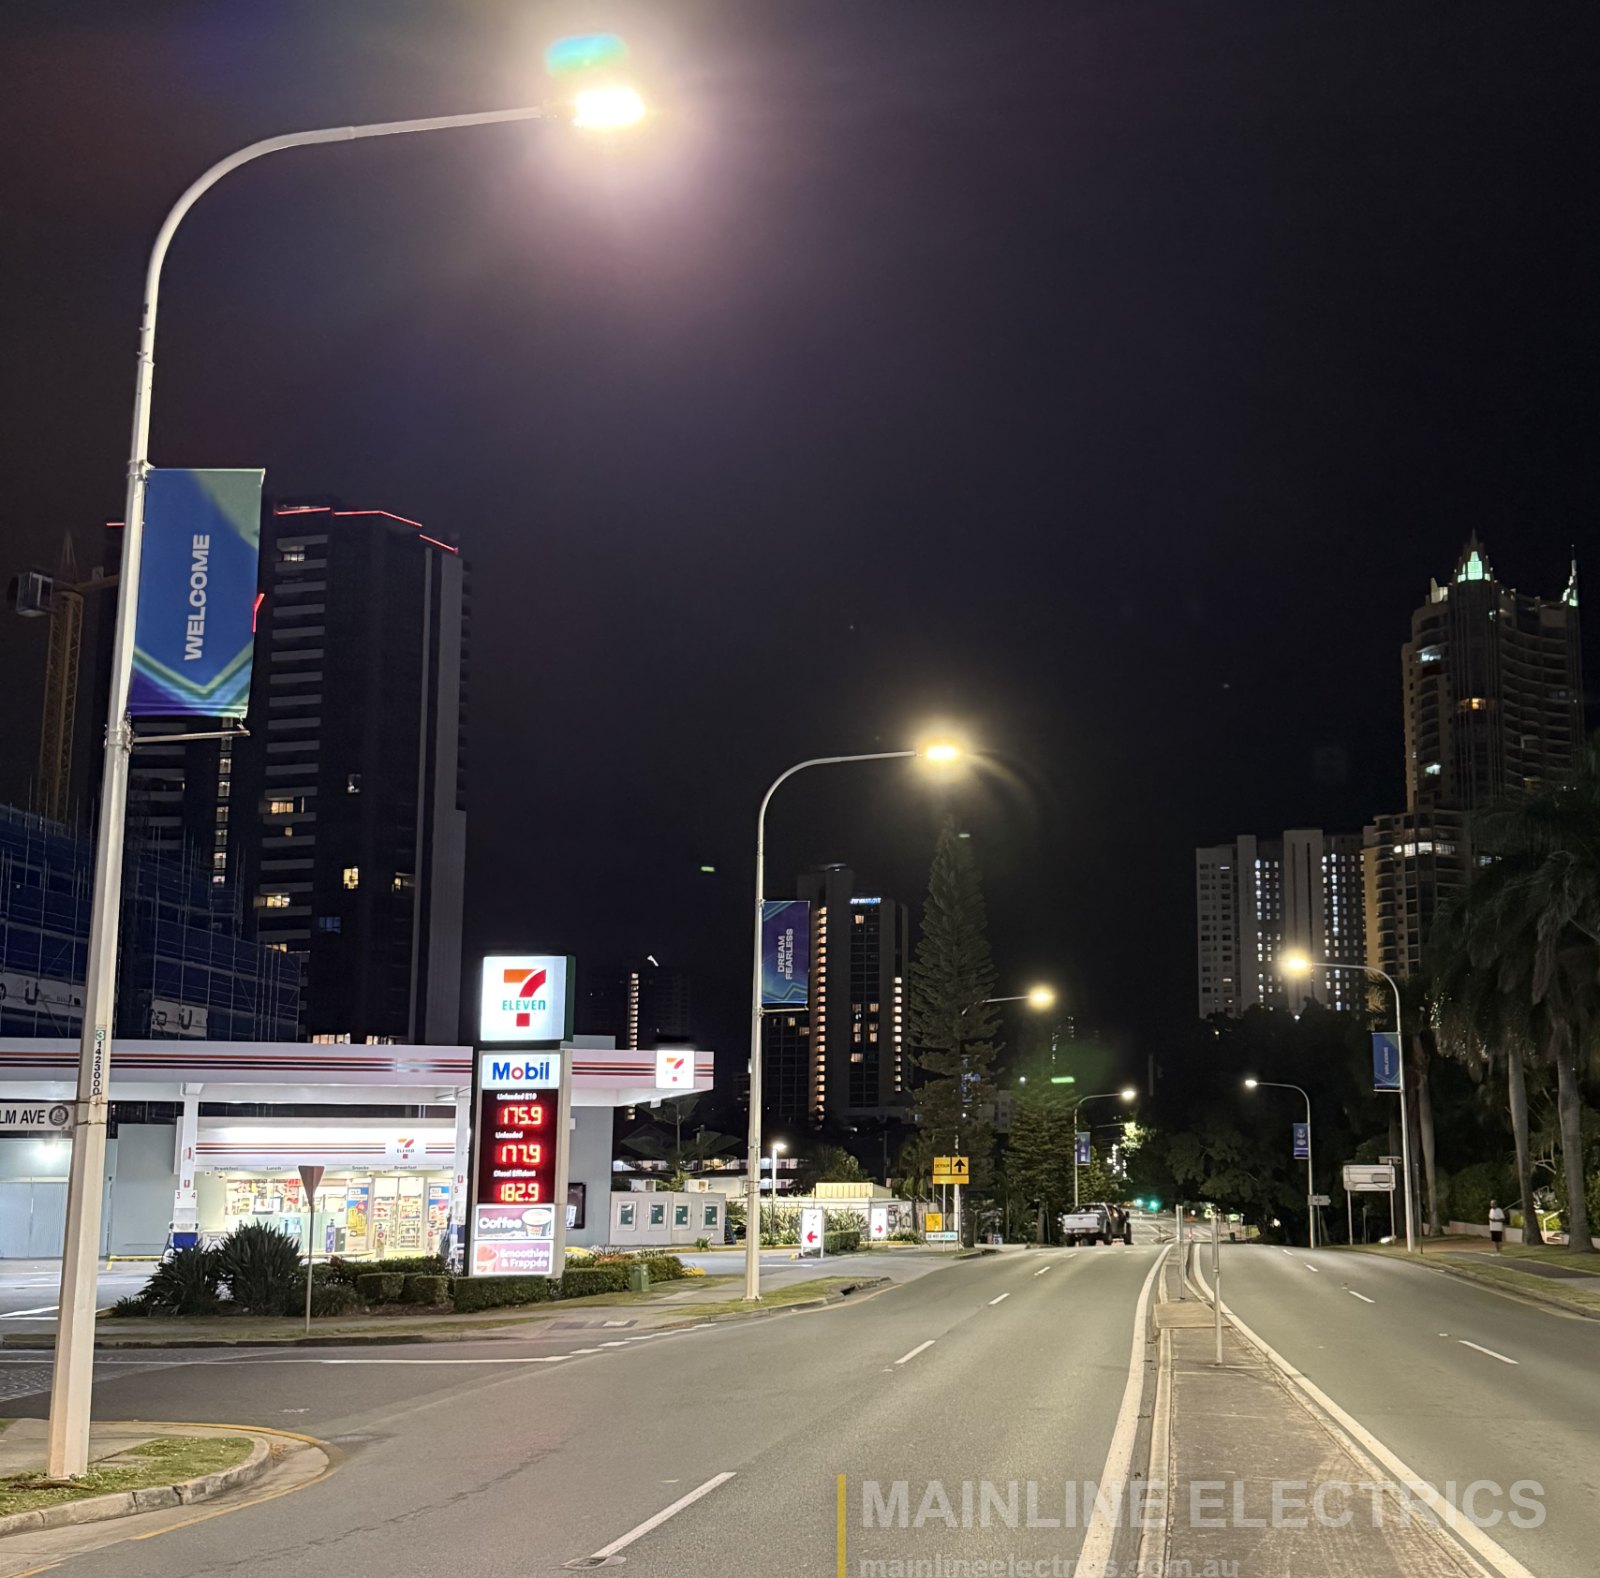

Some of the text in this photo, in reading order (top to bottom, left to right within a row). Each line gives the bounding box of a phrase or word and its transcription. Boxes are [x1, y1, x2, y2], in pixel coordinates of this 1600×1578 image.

[184, 534, 210, 661] WELCOME
[785, 928, 794, 980] FEARLESS
[492, 1062, 550, 1080] Mobil
[20, 1109, 46, 1124] AVE
[503, 1106, 542, 1125] 175.9
[495, 1131, 523, 1139] Unleaded
[501, 1144, 541, 1163] 177.9
[500, 1183, 539, 1202] 182.9
[478, 1216, 523, 1230] Coffee
[500, 1248, 550, 1258] Smoothies
[501, 1259, 509, 1267] &
